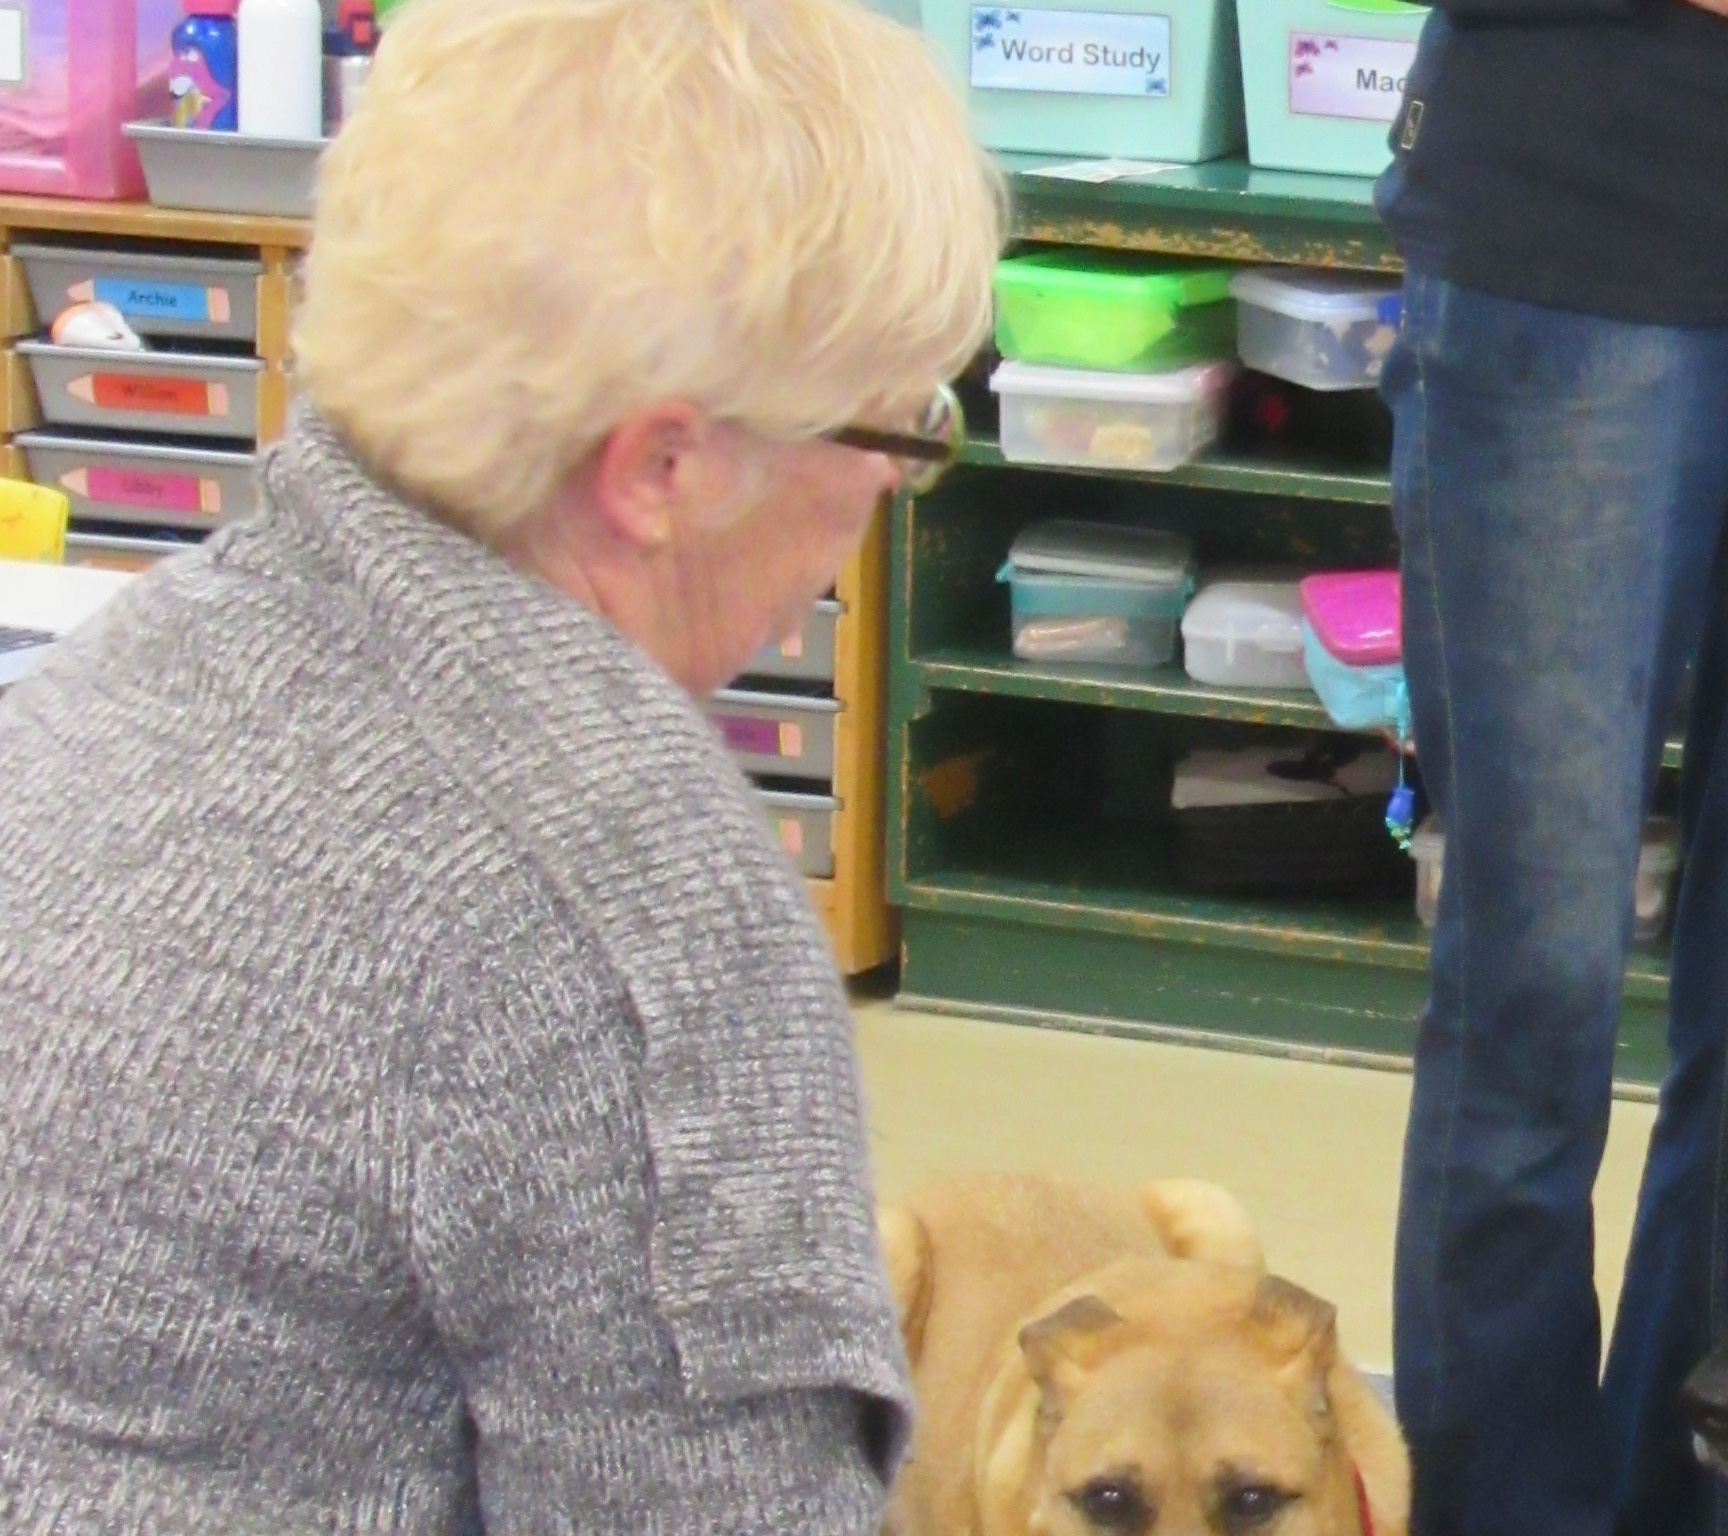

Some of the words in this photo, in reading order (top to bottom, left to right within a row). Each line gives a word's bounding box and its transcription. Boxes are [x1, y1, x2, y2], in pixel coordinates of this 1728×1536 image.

[1001, 37, 1075, 65] Word
[1082, 41, 1162, 73] Study
[127, 289, 178, 309] Archie
[121, 382, 176, 402] William
[122, 476, 163, 499] Libby
